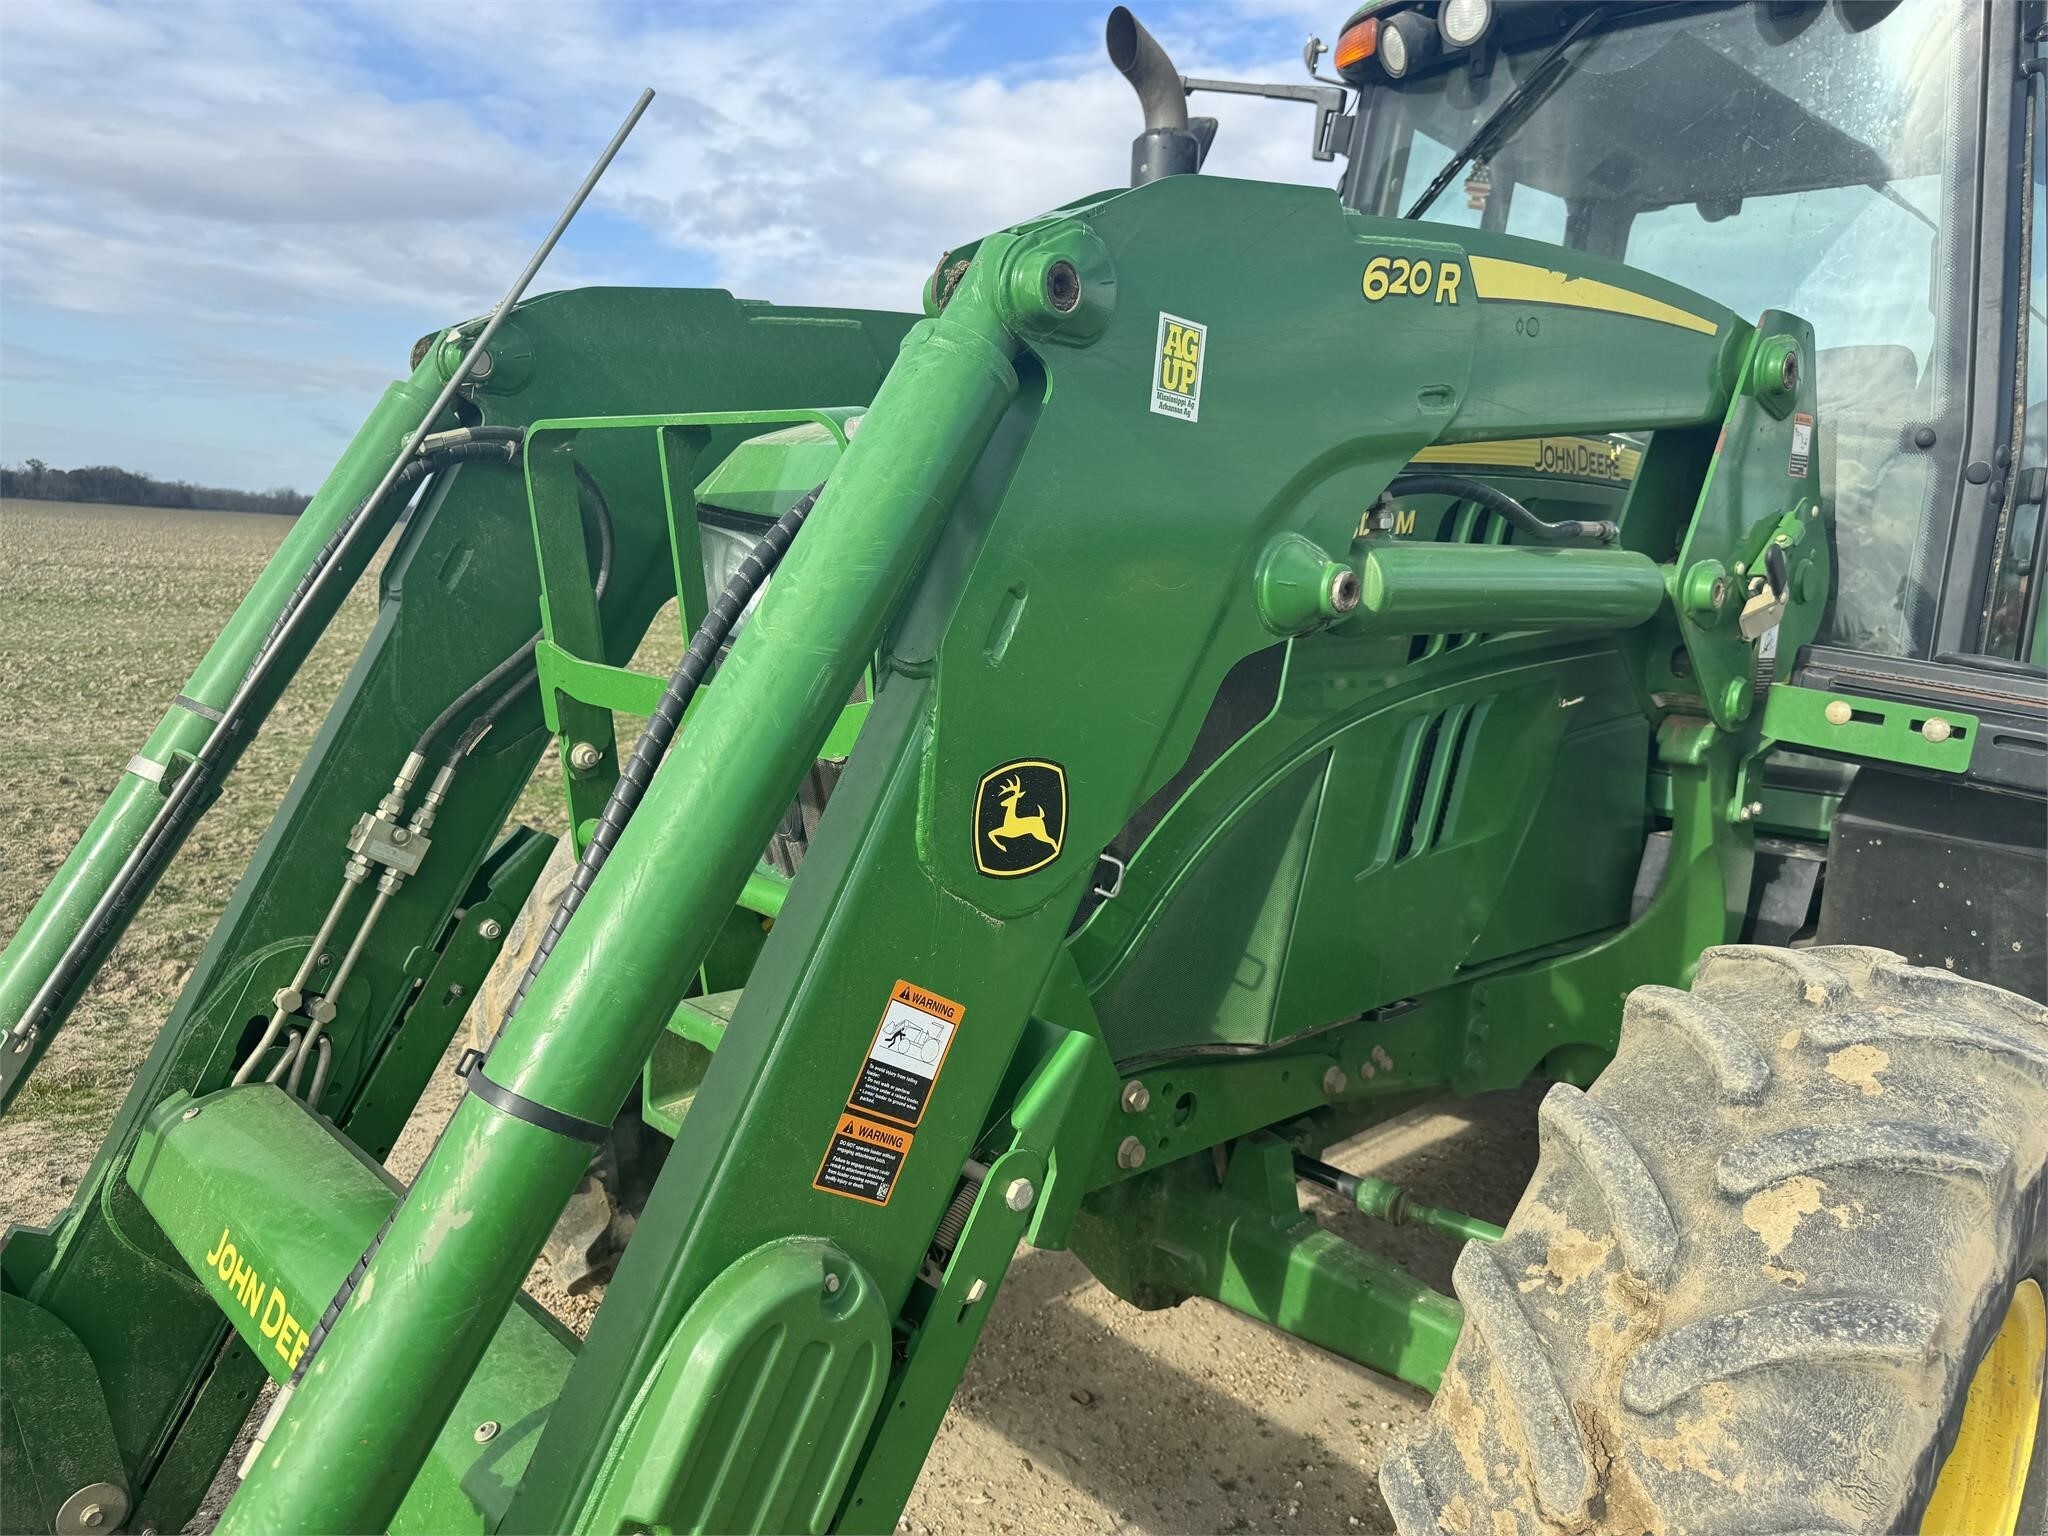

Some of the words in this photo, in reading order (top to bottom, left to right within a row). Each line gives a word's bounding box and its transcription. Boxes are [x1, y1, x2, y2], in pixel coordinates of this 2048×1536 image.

[1164, 323, 1199, 363] AG
[1163, 357, 1196, 394] UP
[1156, 391, 1186, 407] Mississippi
[1187, 400, 1194, 410] Ag
[1159, 401, 1183, 414] Arkansas
[1184, 407, 1191, 418] Ag
[1535, 439, 1575, 472] JOHN
[1578, 445, 1620, 480] DEERE
[912, 992, 955, 1018] WARNING
[858, 1125, 904, 1148] WARNING
[207, 1227, 266, 1319] JOHN
[260, 1286, 310, 1370] DEE
